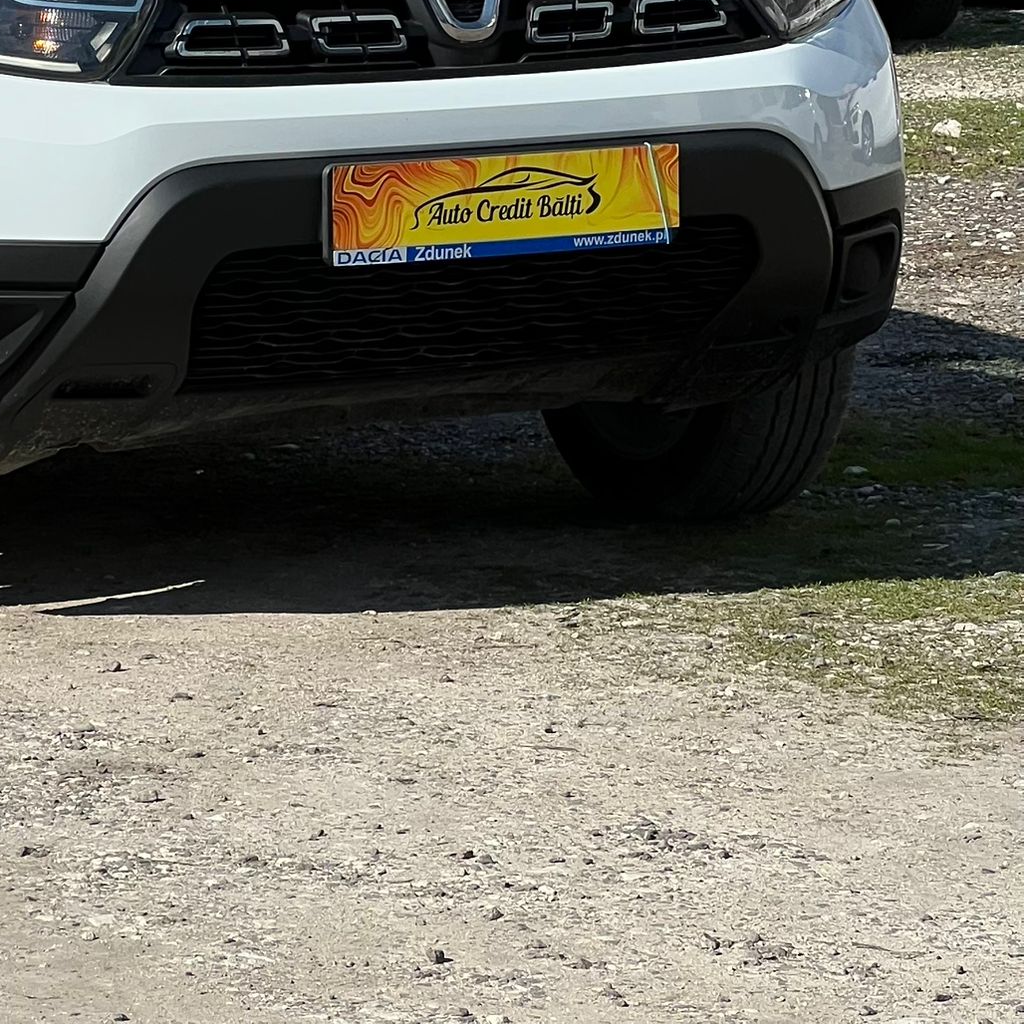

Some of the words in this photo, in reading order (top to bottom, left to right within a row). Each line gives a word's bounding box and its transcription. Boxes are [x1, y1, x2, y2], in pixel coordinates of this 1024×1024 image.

[427, 202, 474, 227] Auto
[476, 199, 533, 222] Credit
[337, 249, 403, 266] DACIA
[414, 244, 473, 262] Zdunek
